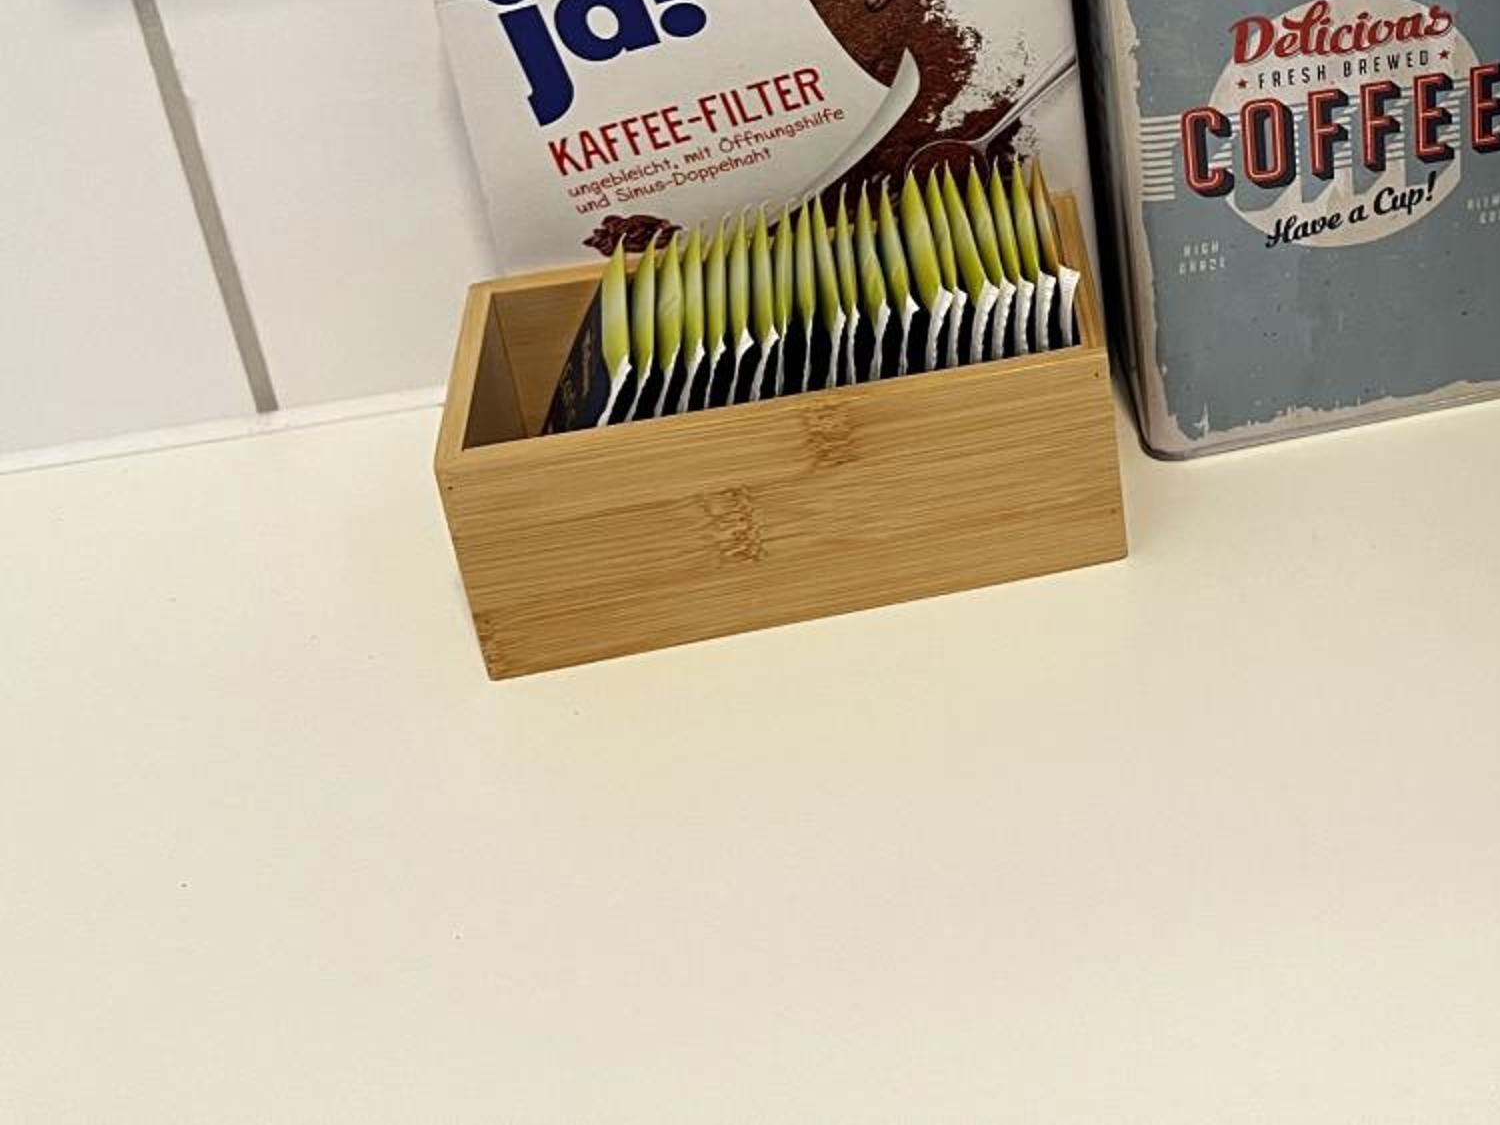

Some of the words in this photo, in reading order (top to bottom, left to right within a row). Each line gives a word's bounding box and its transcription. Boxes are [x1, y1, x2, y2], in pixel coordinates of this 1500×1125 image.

[1257, 64, 1328, 90] FRESH
[1343, 49, 1430, 77] BREWED
[548, 67, 826, 177] KAFFEE-FILTER
[567, 157, 680, 198] ungebleicht,
[683, 146, 712, 166] mit
[576, 194, 611, 215] und
[615, 147, 772, 204] Sinus-Doppelnaht
[1264, 215, 1343, 249] Have
[1348, 206, 1369, 225] a
[1373, 171, 1438, 216] Cup!
